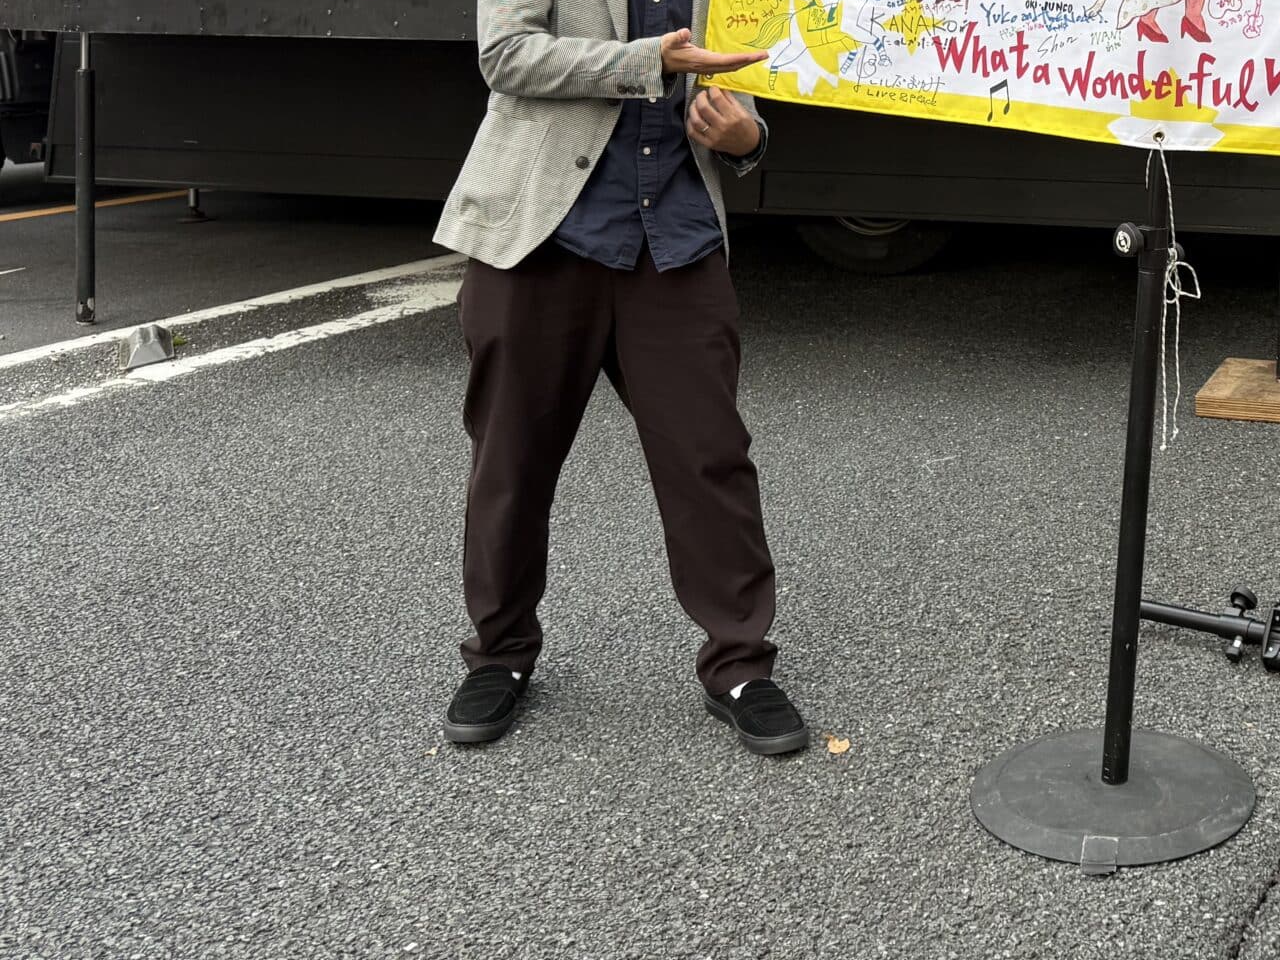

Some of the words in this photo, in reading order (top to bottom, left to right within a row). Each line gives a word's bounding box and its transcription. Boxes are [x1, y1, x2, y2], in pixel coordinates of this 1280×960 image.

[871, 6, 957, 36] KANAKO
[933, 21, 1029, 79] What
[1033, 62, 1051, 85] a
[1058, 48, 1258, 112] Wonderful
